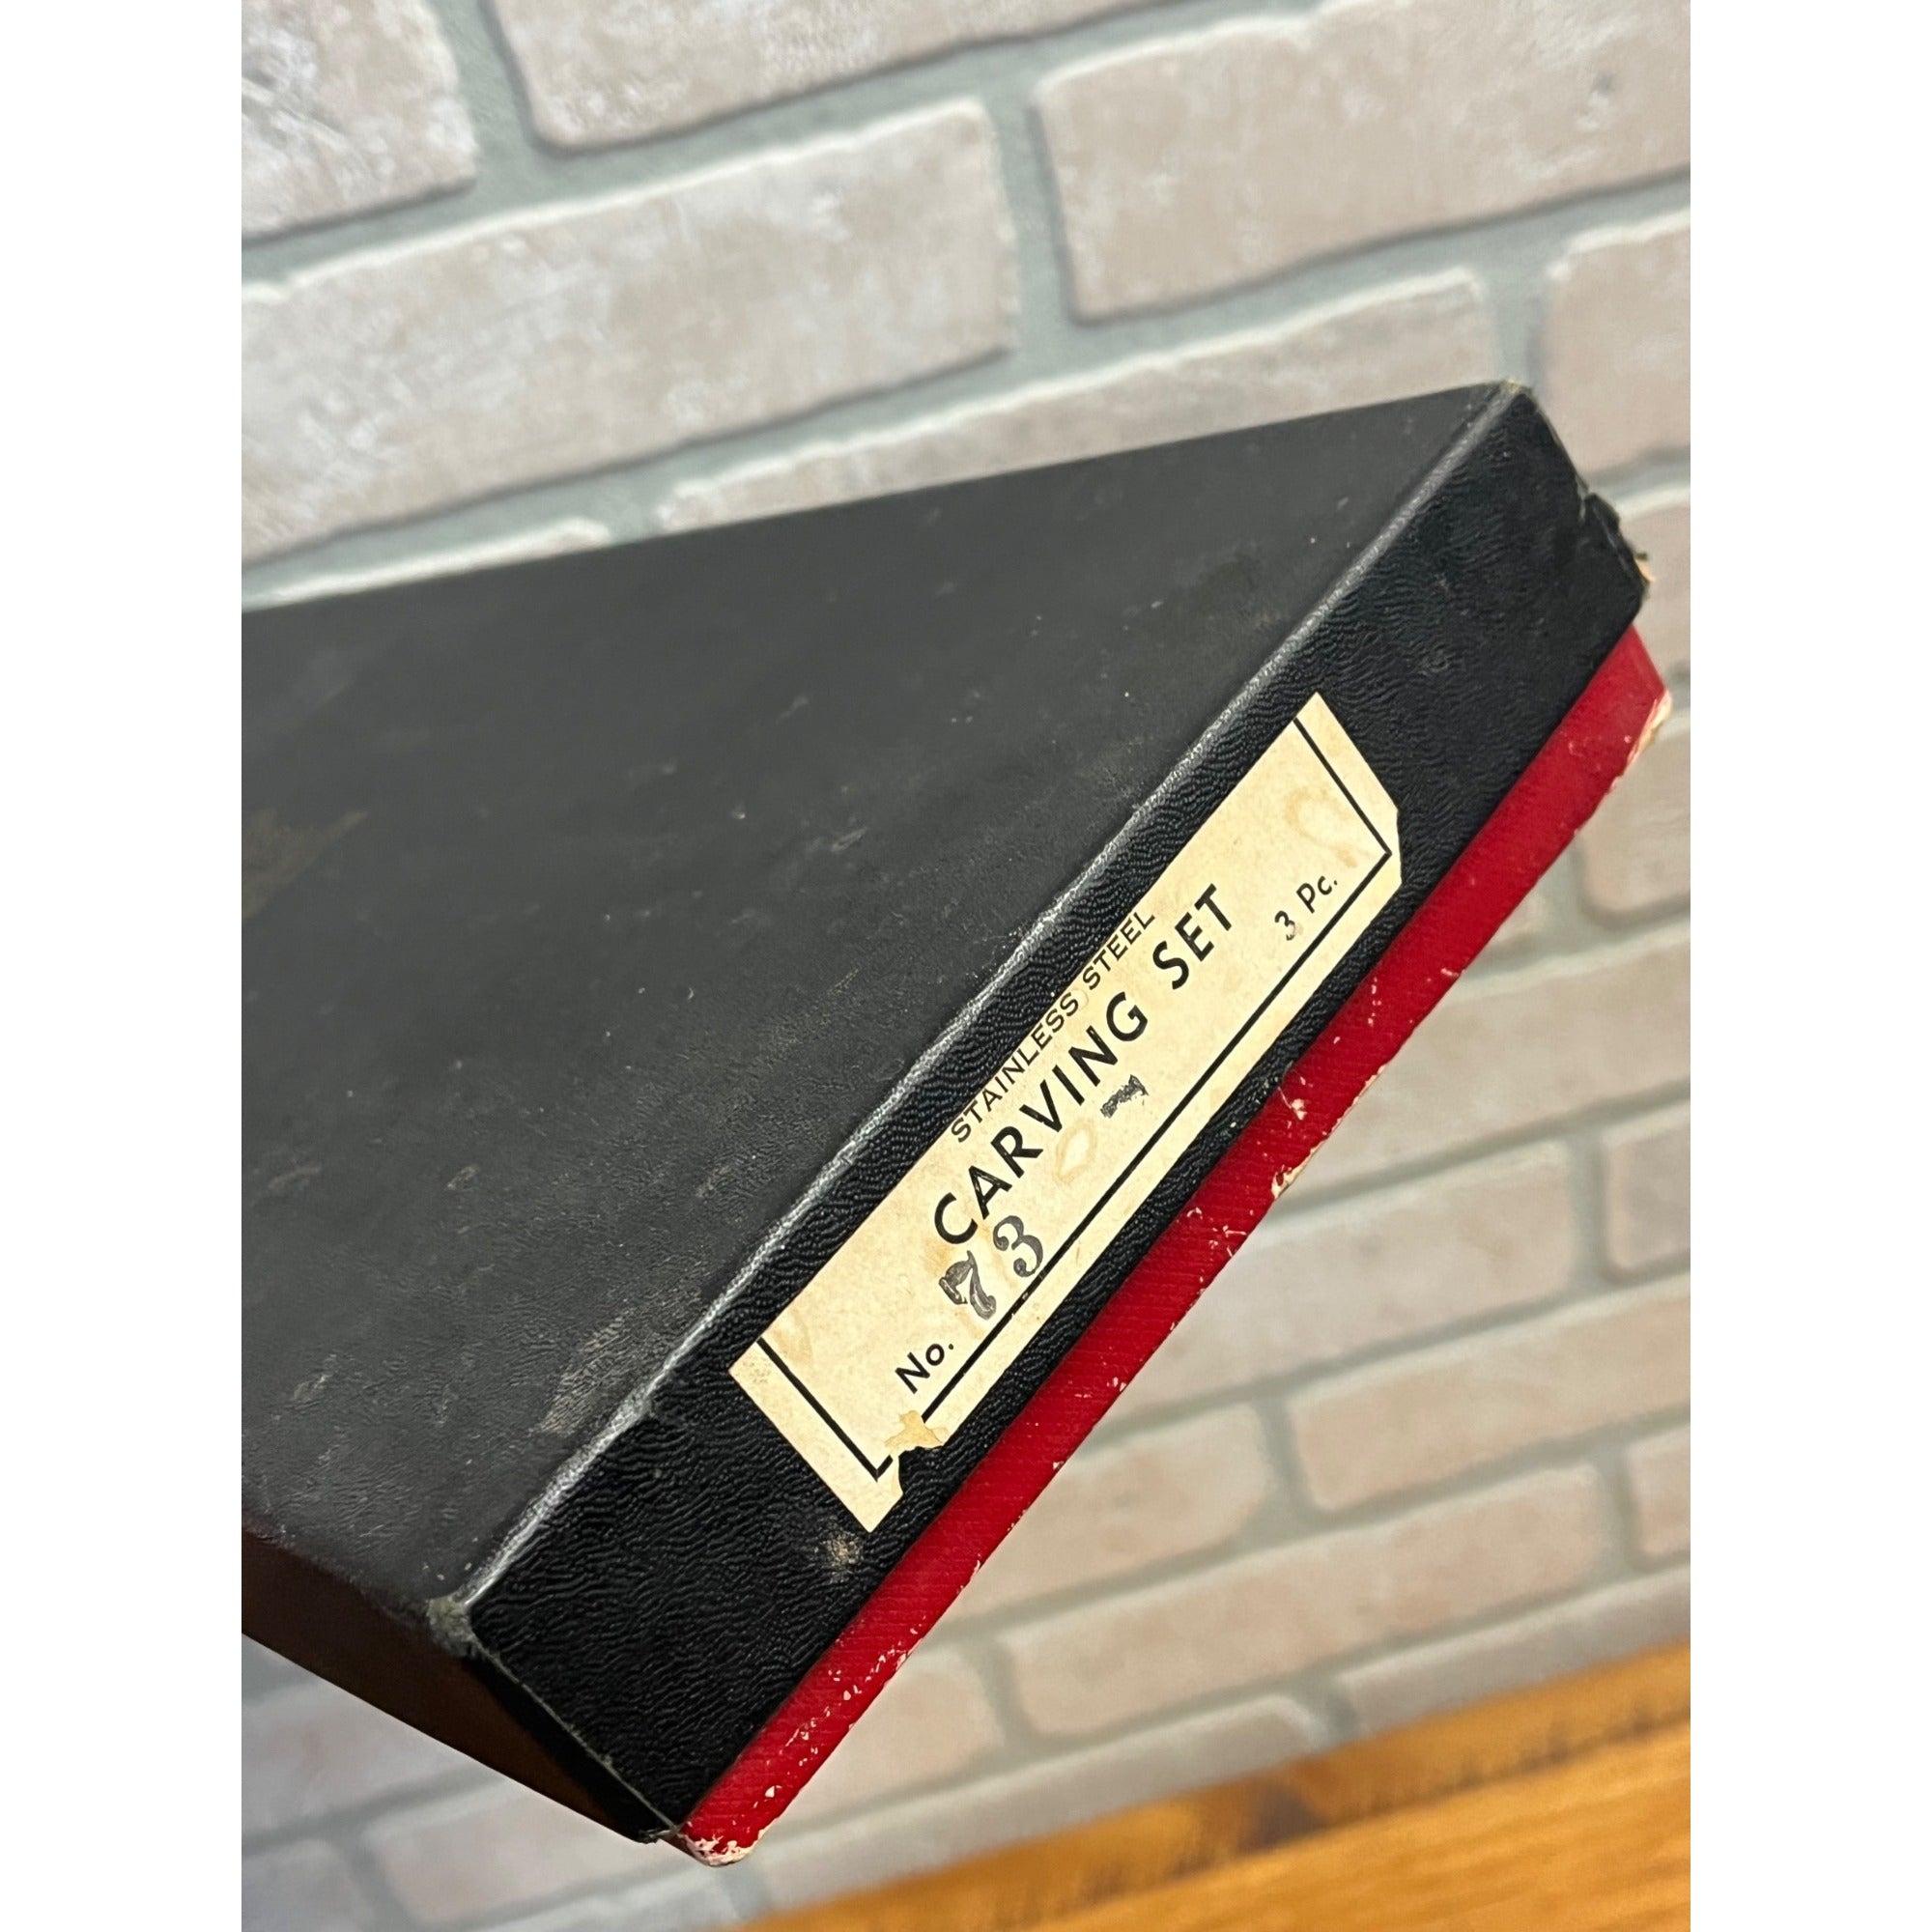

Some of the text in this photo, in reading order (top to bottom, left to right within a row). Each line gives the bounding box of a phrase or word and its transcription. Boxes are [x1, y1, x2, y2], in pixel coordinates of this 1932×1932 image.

[1274, 874, 1340, 942] 3 Pc.
[933, 884, 1233, 1245] CARVING SET
[952, 993, 1080, 1143] STAINLESS
[1082, 912, 1156, 990] STEEL
[895, 1215, 1044, 1394] No. 73
